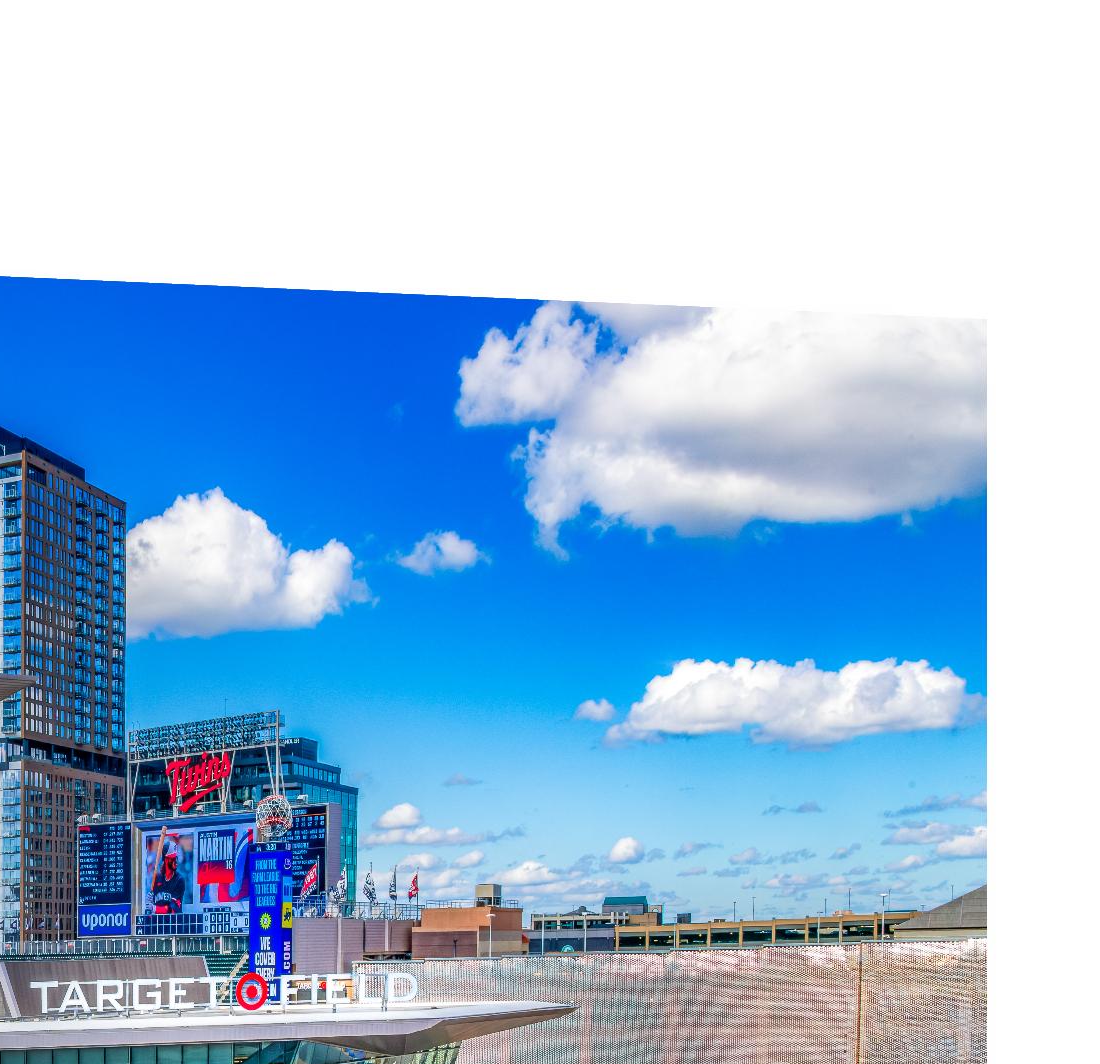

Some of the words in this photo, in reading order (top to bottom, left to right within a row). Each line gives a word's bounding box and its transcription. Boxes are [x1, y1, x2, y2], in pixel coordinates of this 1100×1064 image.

[166, 752, 231, 812] Twins
[200, 836, 232, 861] MARTIN
[226, 860, 233, 869] 16
[82, 913, 128, 930] uponor
[260, 936, 270, 950] WE
[254, 952, 276, 966] COVER
[255, 967, 275, 981] EVERY
[30, 977, 221, 1014] TARGET
[280, 972, 419, 1006] FIELD
